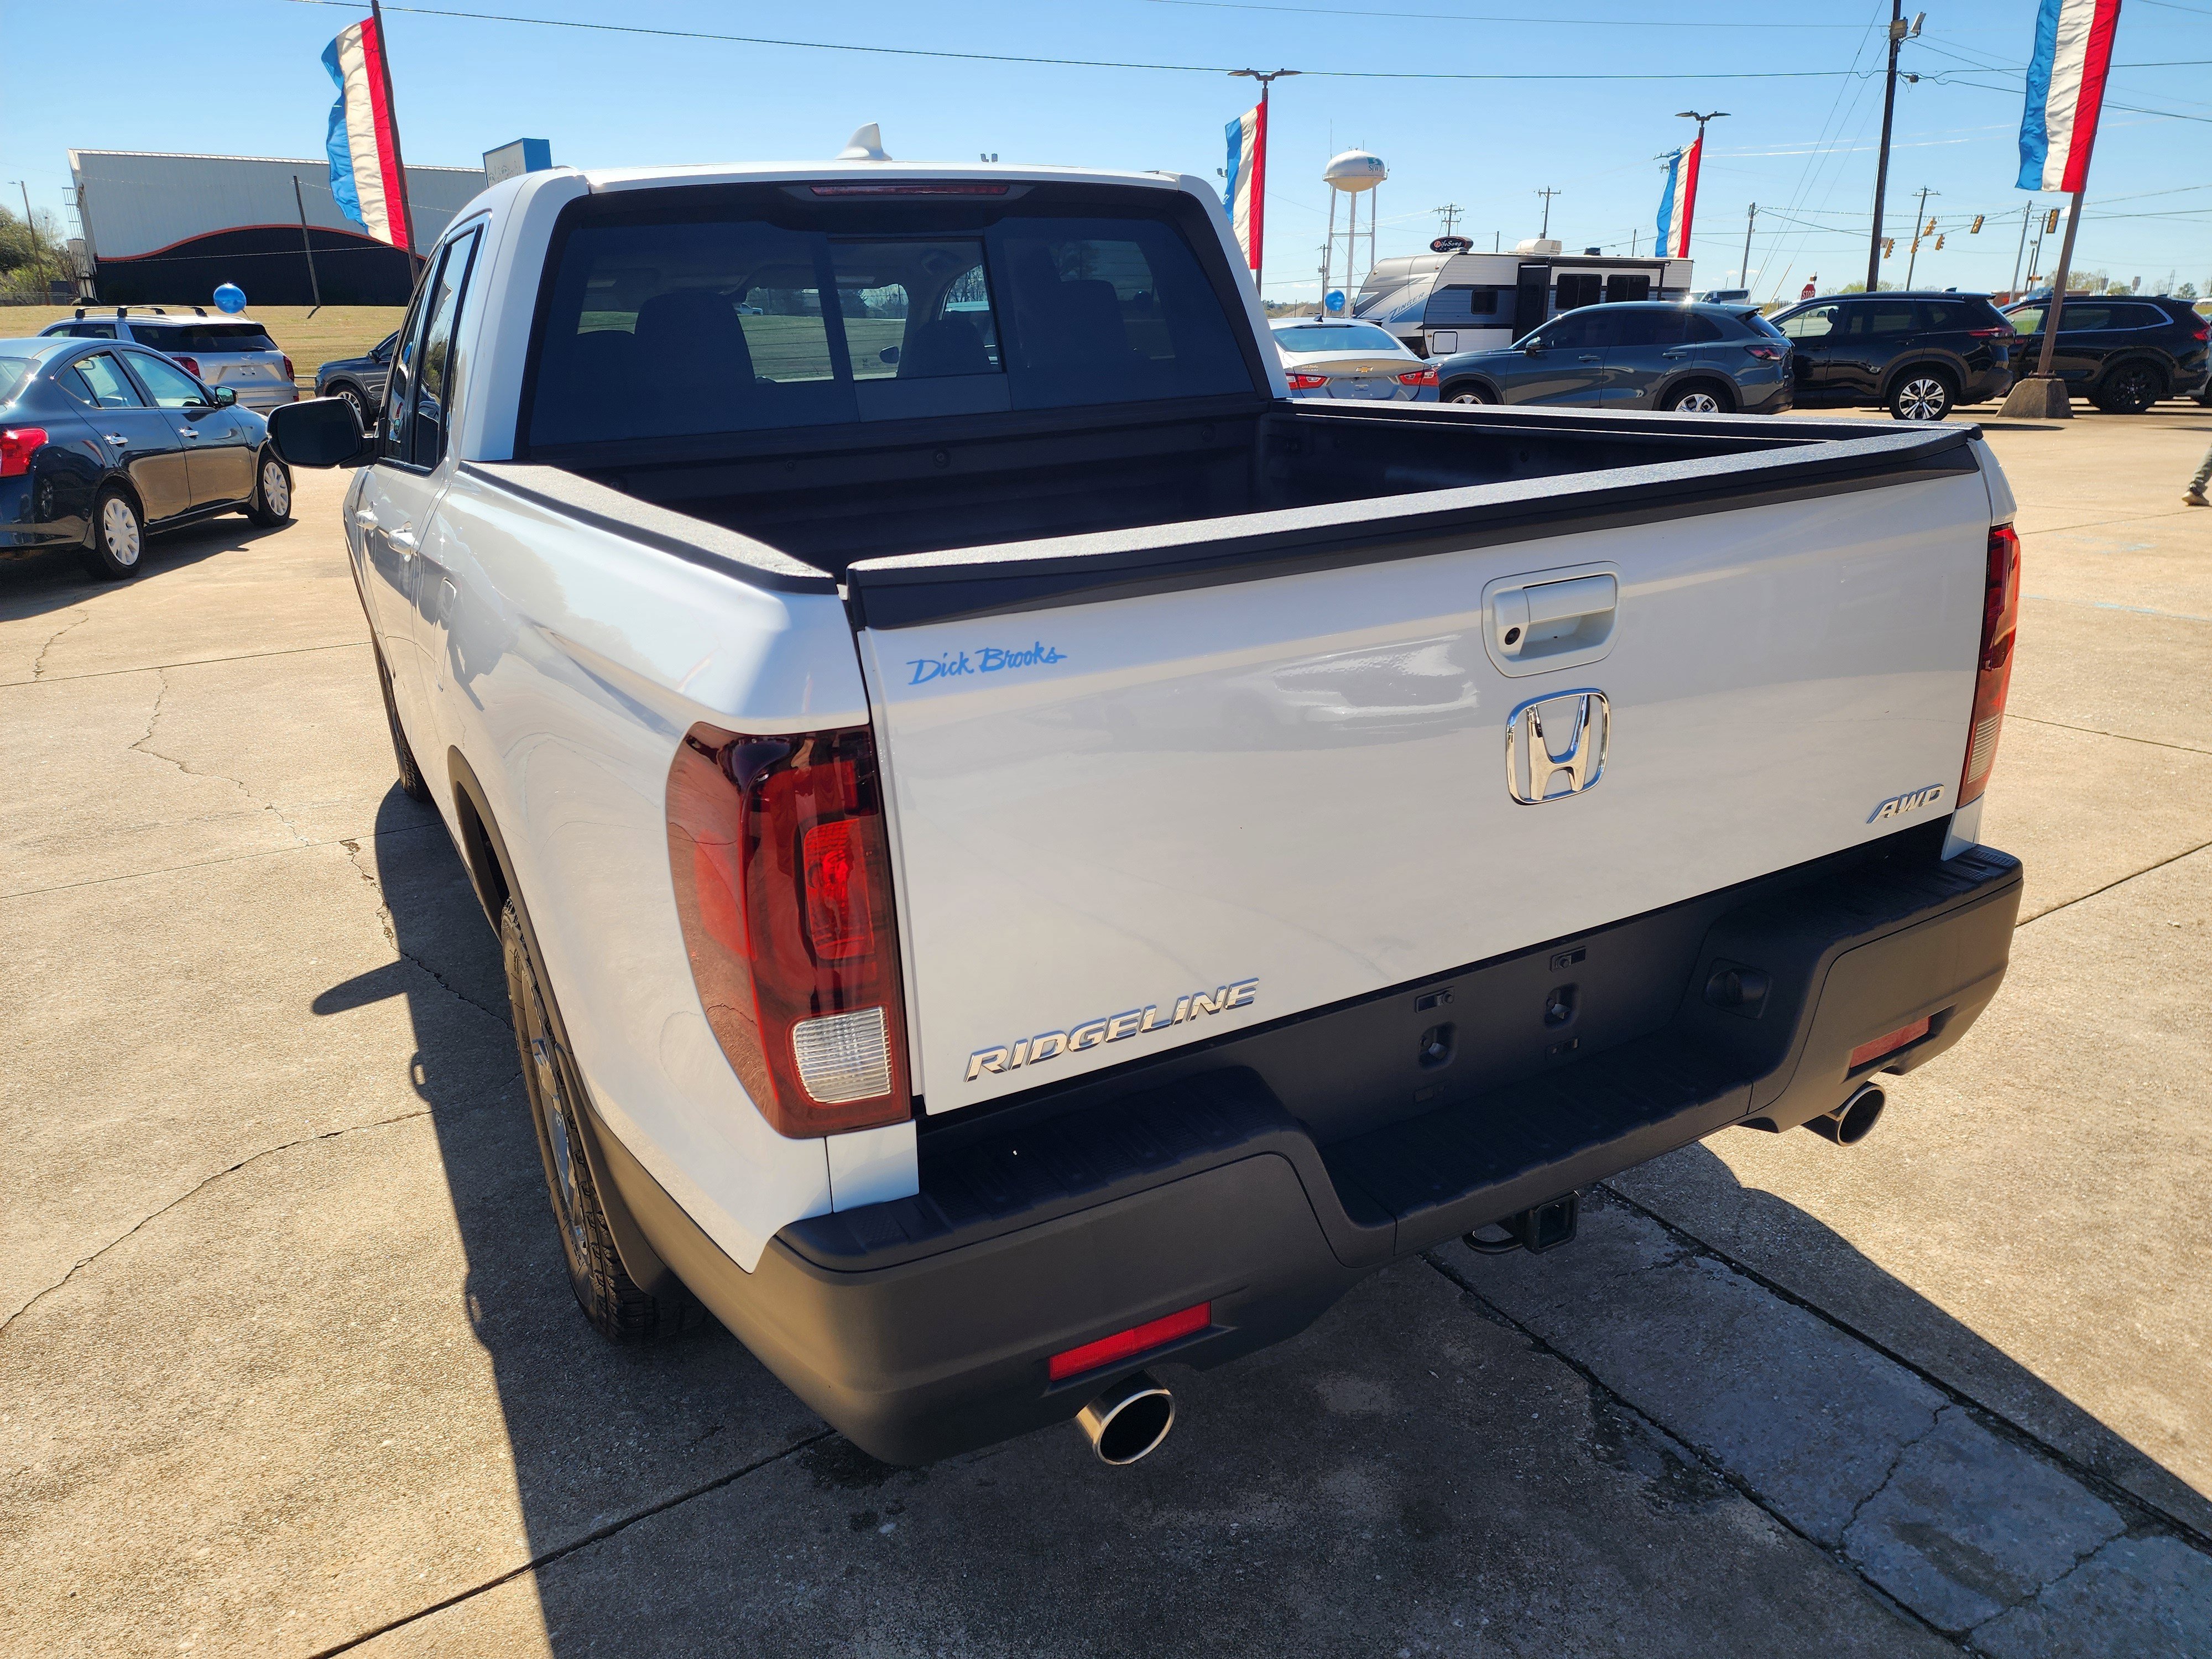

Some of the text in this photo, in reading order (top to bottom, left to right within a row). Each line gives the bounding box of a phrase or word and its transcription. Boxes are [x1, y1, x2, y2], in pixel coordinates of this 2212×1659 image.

[1389, 292, 1425, 322] ZINGER
[1802, 290, 1815, 299] STOP
[906, 641, 1067, 685] Dick Brooks
[1866, 783, 1945, 824] AWD
[963, 977, 1259, 1083] RIDGELINE
